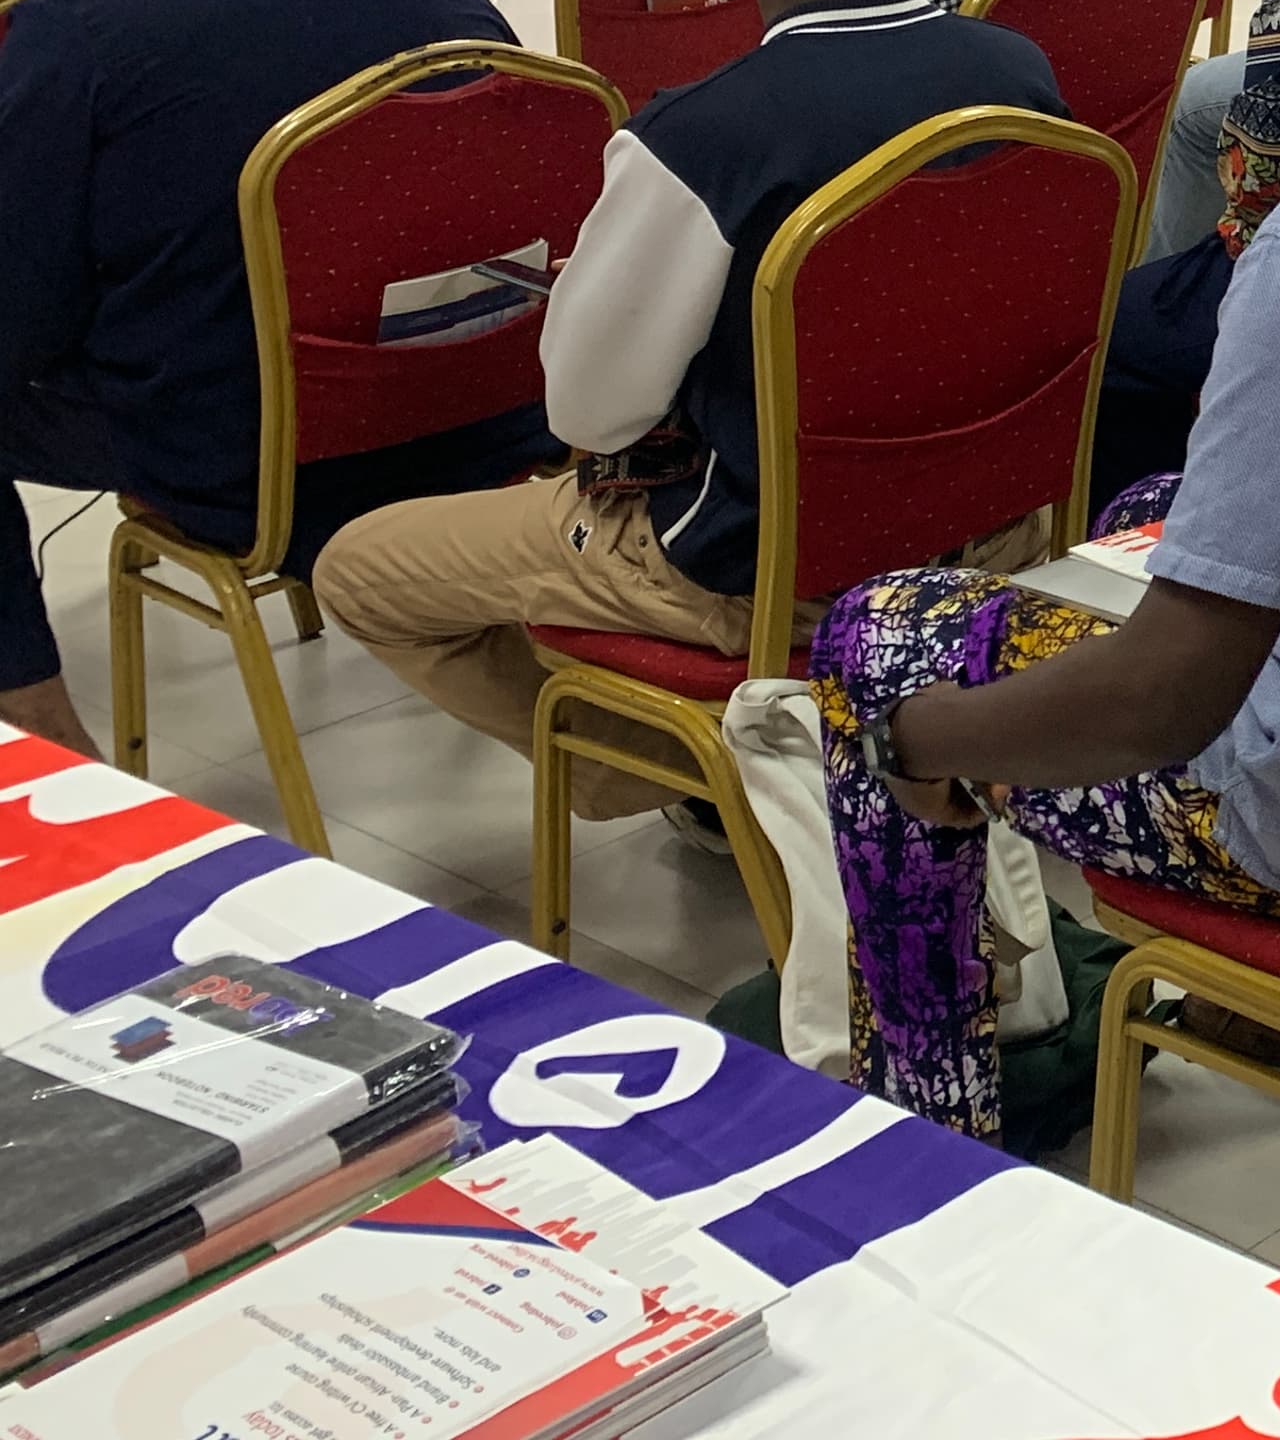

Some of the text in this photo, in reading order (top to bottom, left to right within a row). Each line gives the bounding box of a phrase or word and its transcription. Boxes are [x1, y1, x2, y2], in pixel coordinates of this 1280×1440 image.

[465, 1298, 488, 1312] with
[241, 1305, 293, 1338] community
[485, 1310, 524, 1333] Connect
[288, 1333, 329, 1361] learning
[368, 1324, 434, 1360] development
[459, 1345, 482, 1362] lots
[474, 1357, 501, 1372] and
[285, 1363, 319, 1384] course
[325, 1356, 358, 1376] online
[337, 1333, 450, 1404] Brand ambassador deals
[430, 1358, 476, 1389] Software
[315, 1379, 351, 1403] writing
[354, 1373, 392, 1396] African
[345, 1400, 367, 1414] CV
[242, 1410, 285, 1440] today
[280, 1409, 313, 1430] access
[364, 1410, 388, 1428] free
[307, 1427, 333, 1440] get
